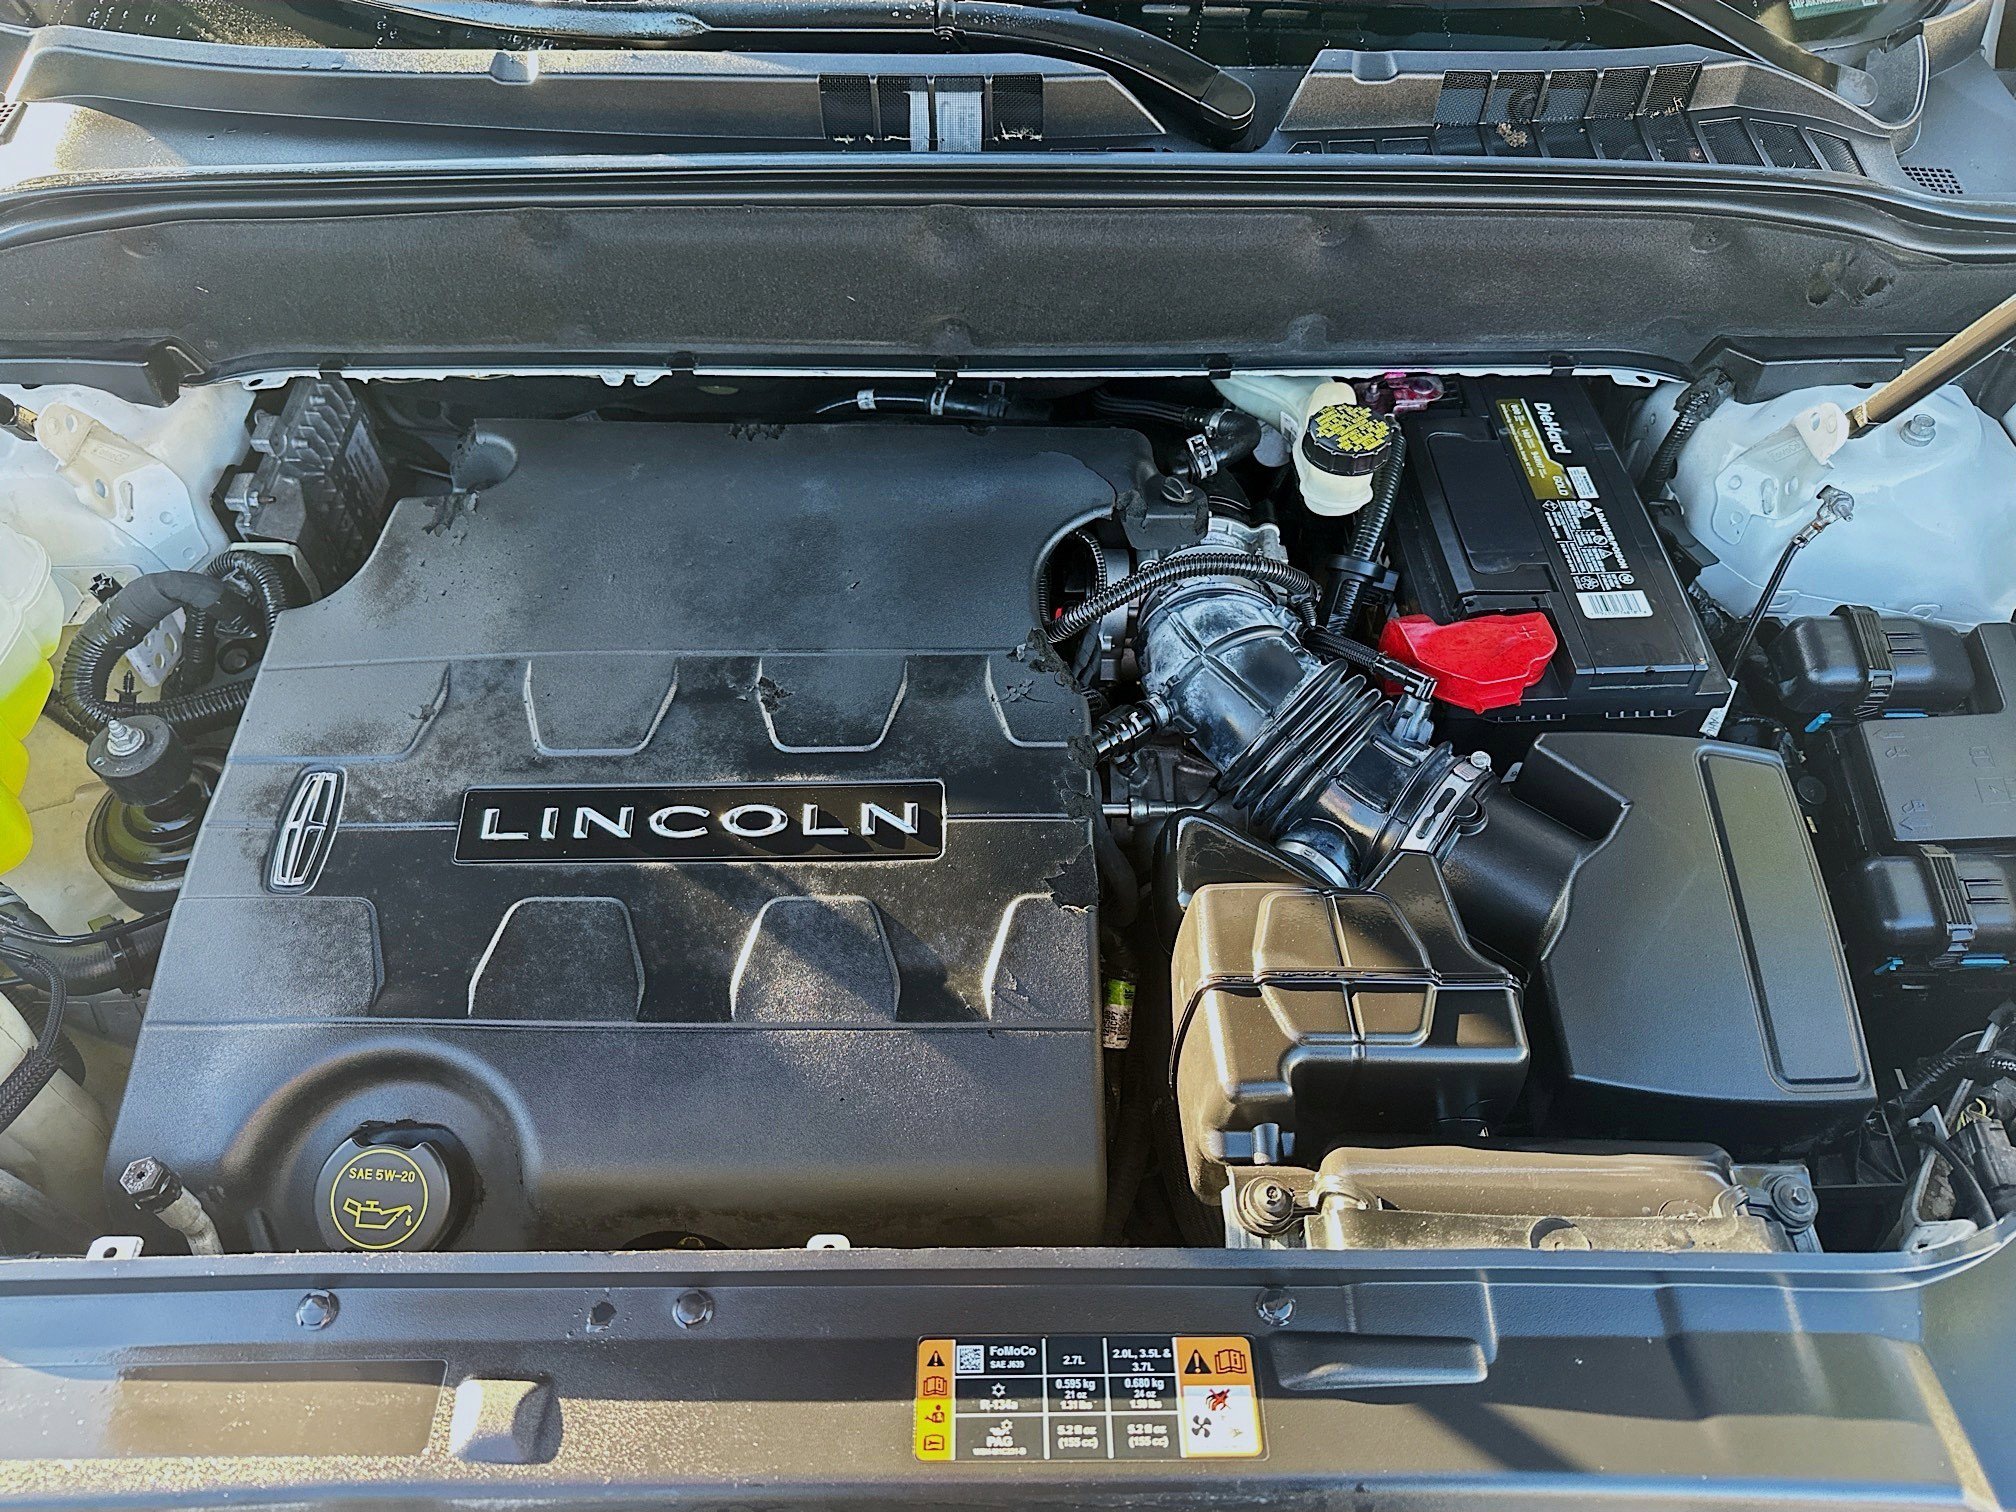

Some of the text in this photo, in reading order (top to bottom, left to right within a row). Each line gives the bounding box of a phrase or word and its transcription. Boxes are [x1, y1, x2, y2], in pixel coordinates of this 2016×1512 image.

[1534, 403, 1572, 454] DieHard
[1552, 476, 1569, 496] GOLD
[1597, 512, 1629, 569] DANGER/POISON
[480, 803, 918, 840] LINCOLN
[349, 1168, 416, 1183] SAE 5W-20
[989, 1346, 1037, 1356] FoMoCo
[1112, 1348, 1172, 1359] 2.0L, 3.5L &
[990, 1360, 1006, 1369] SAE
[1062, 1355, 1086, 1365] 2.7L
[1131, 1361, 1155, 1371] 3.7L
[1055, 1378, 1096, 1391] 0.595 kg
[1124, 1377, 1165, 1390] 0.680 kg
[1064, 1390, 1087, 1399] 21 oz
[1133, 1389, 1157, 1398] 24 oz
